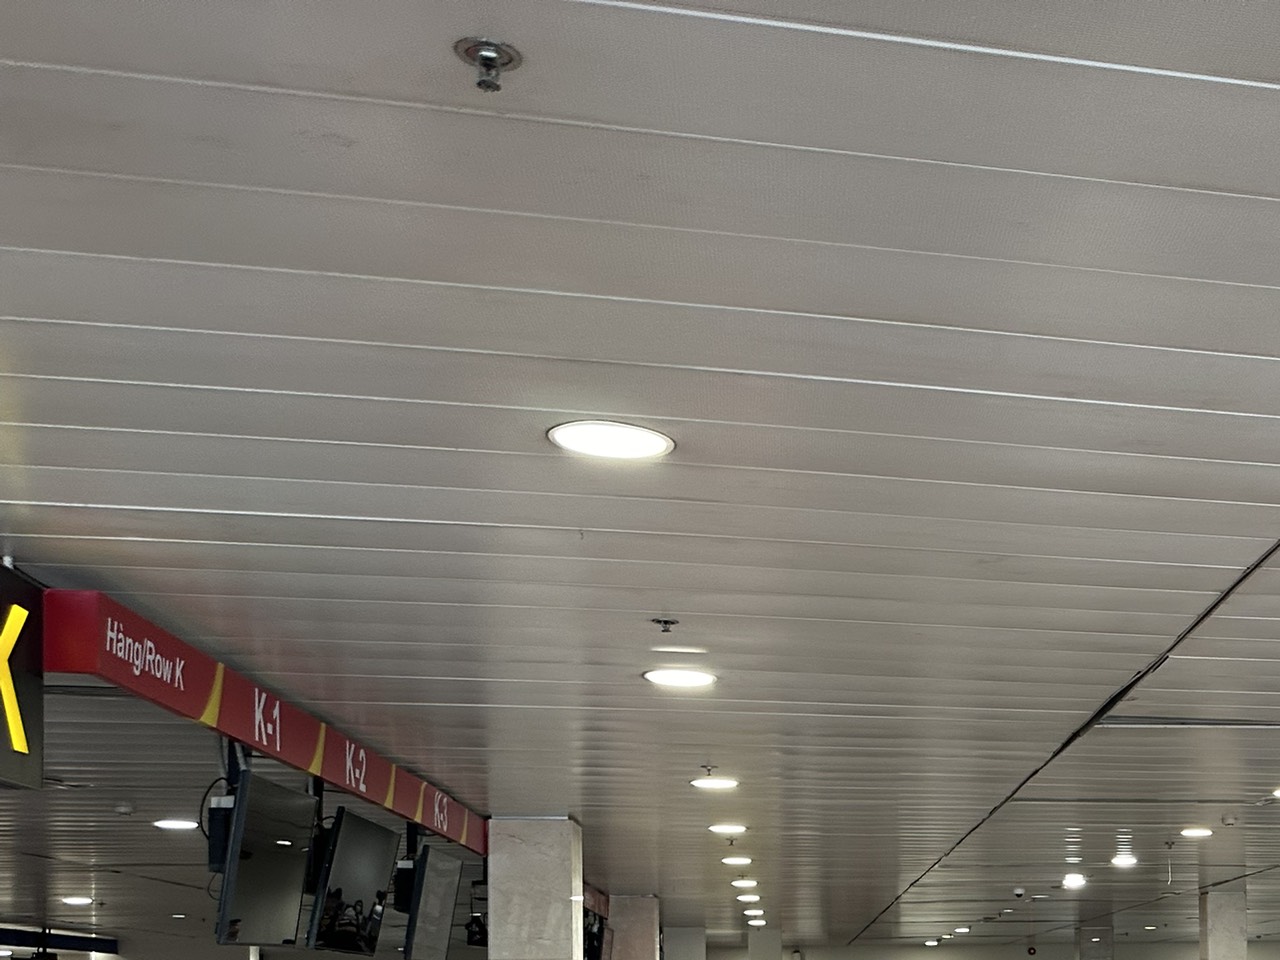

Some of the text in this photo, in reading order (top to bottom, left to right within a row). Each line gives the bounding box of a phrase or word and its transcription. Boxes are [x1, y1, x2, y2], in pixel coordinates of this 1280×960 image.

[106, 617, 185, 691] Hàng/Row K
[254, 688, 280, 751] K-1
[346, 740, 367, 793] K-2
[434, 791, 448, 832] K-3
